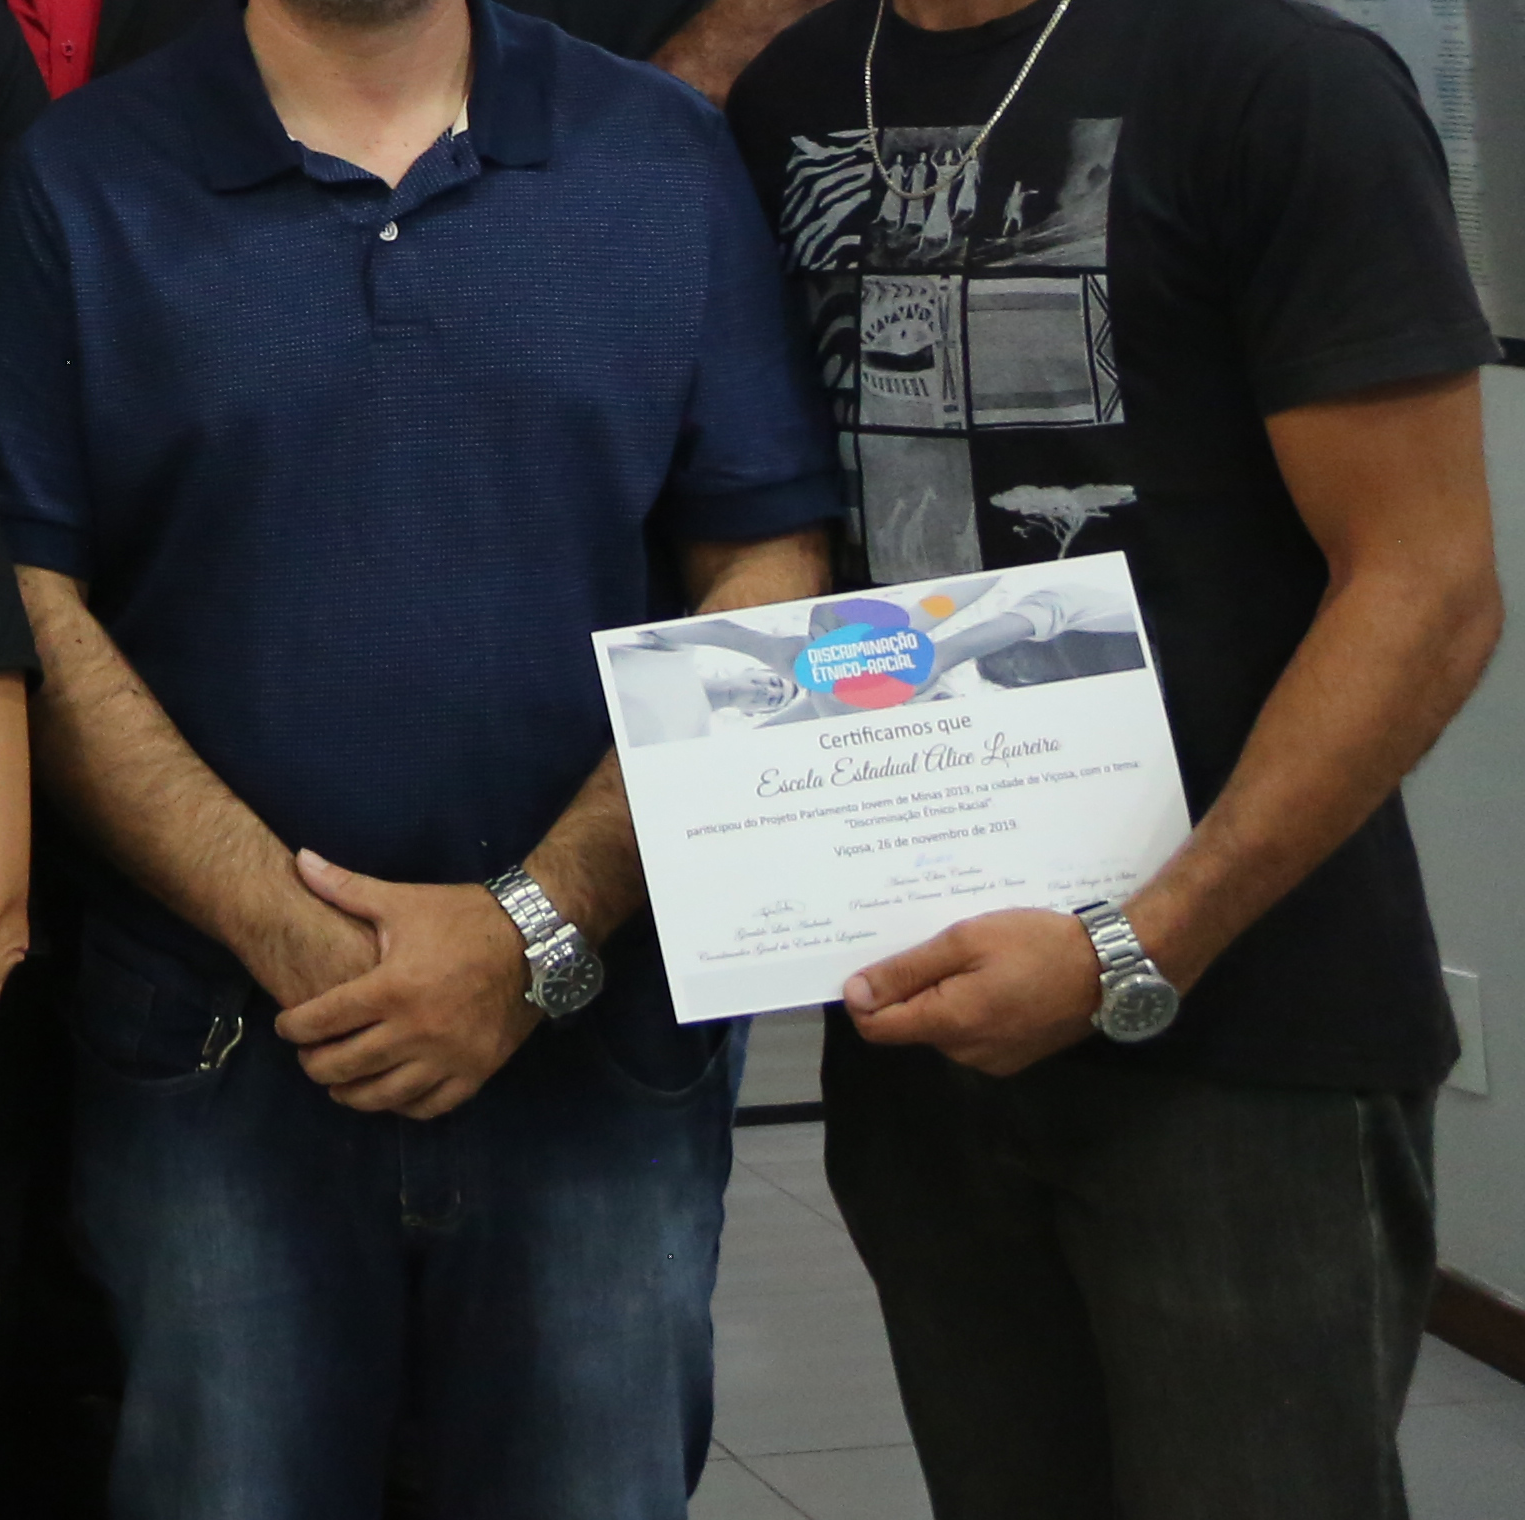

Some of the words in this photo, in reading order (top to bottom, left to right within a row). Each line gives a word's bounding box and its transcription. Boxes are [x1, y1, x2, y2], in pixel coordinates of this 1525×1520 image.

[807, 631, 918, 665] DISCRIMINAÇÃO
[810, 653, 917, 683] ÉTNICO-RACIAL
[819, 721, 934, 751] Certificamos
[936, 713, 972, 738] que
[756, 768, 824, 798] Escola
[830, 752, 917, 787] Estadual
[924, 743, 975, 772] Alice
[981, 732, 1061, 768] Loureiro
[686, 821, 742, 839] participou
[744, 818, 758, 829] do
[760, 812, 797, 826] Projeto
[799, 803, 859, 820] Parlamento
[861, 798, 894, 812] Jovem
[896, 794, 909, 805] de
[911, 791, 943, 803] Minas
[976, 783, 989, 793] na
[991, 776, 1024, 790] cidade
[1027, 774, 1040, 785] de
[1080, 766, 1102, 777] com
[834, 842, 875, 858] Viçosa,
[877, 839, 892, 851] 26
[894, 836, 909, 847] de
[912, 827, 969, 846] novembro
[971, 824, 986, 836] de
